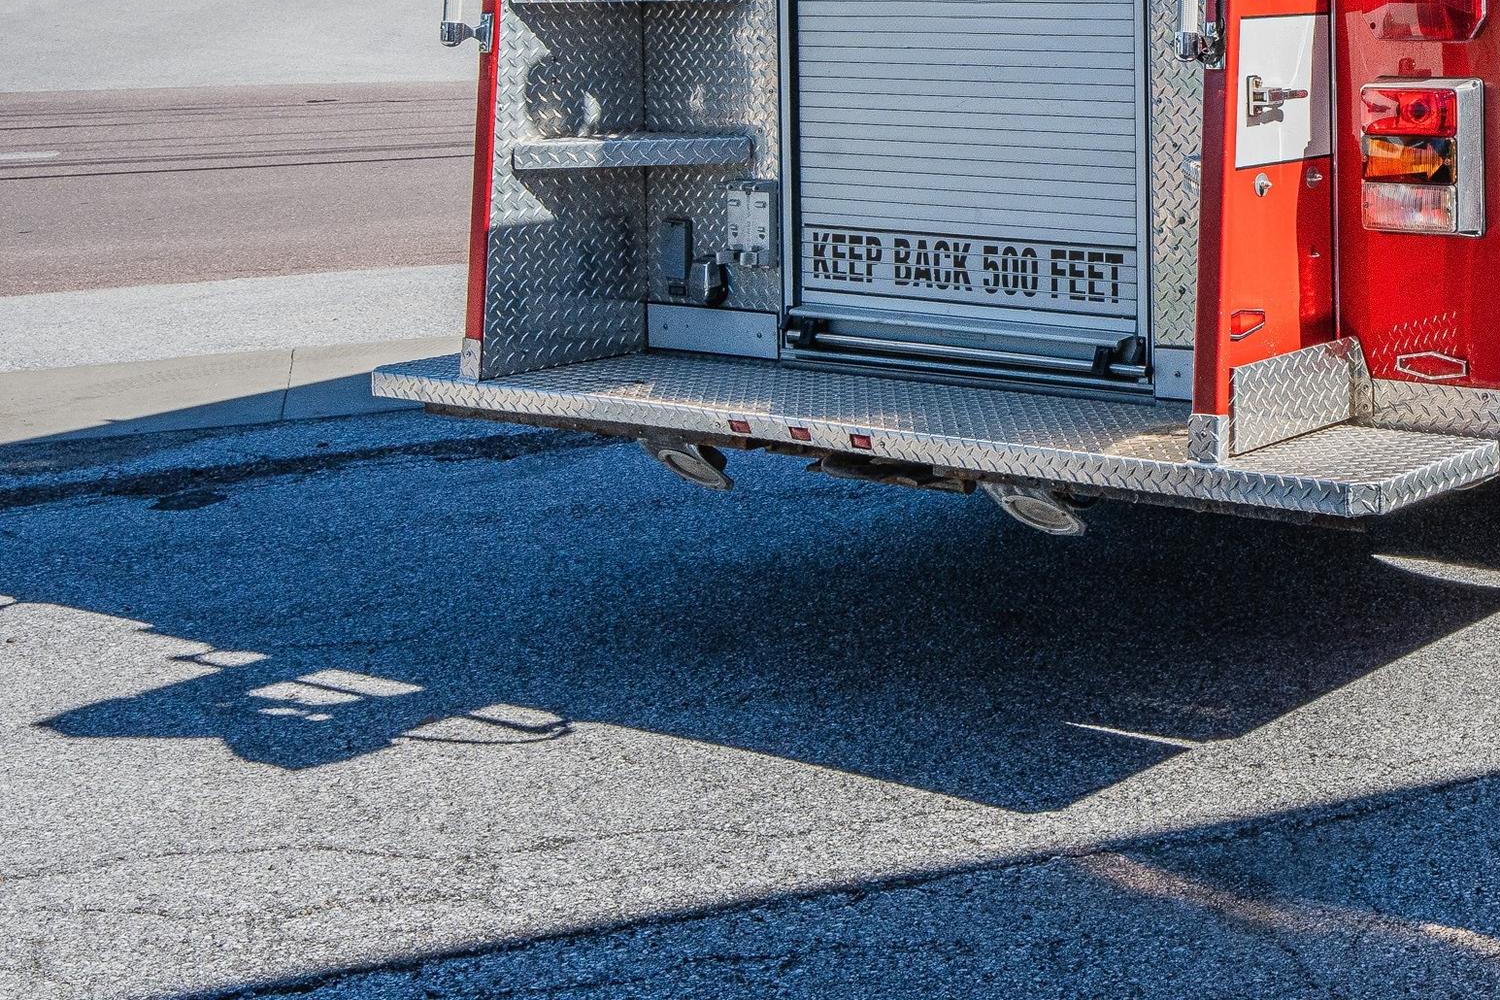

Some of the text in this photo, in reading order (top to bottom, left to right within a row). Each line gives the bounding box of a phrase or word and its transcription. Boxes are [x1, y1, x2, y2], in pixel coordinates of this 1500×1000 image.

[812, 231, 1124, 304] KEEP BACK 500 FEET
